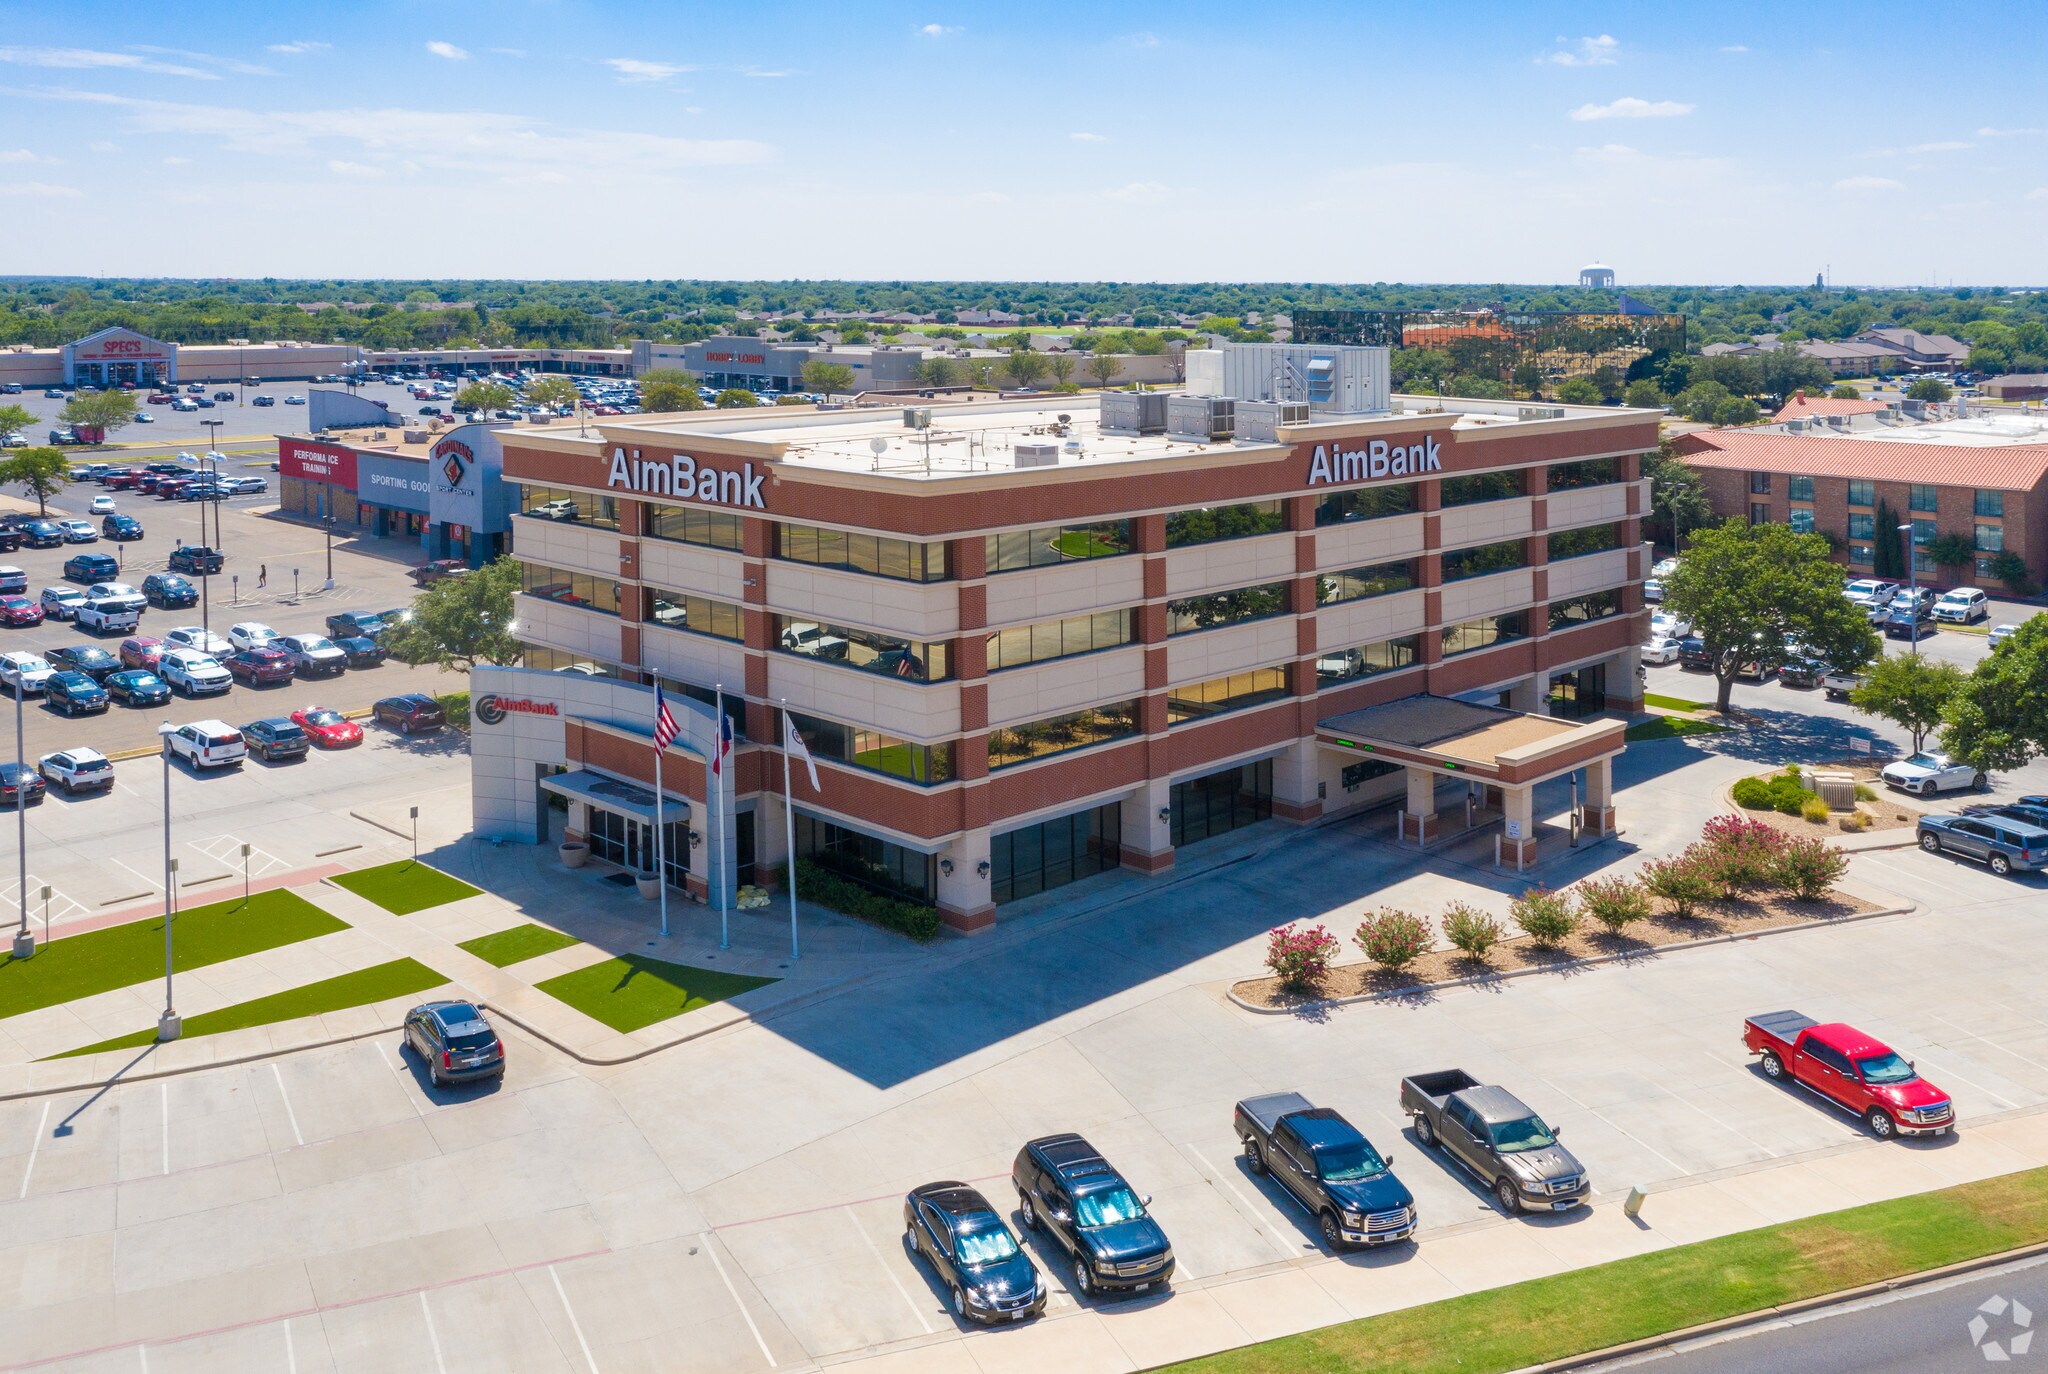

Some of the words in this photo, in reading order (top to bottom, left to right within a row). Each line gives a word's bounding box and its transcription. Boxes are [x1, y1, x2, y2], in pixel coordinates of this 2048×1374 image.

[104, 341, 141, 353] SPEC'S
[706, 352, 733, 362] HOBBY
[737, 353, 765, 365] LOBBY
[1308, 435, 1442, 485] AimBank
[371, 474, 408, 489] SPORTING
[607, 447, 765, 509] AimBank
[493, 696, 559, 716] AimBank
